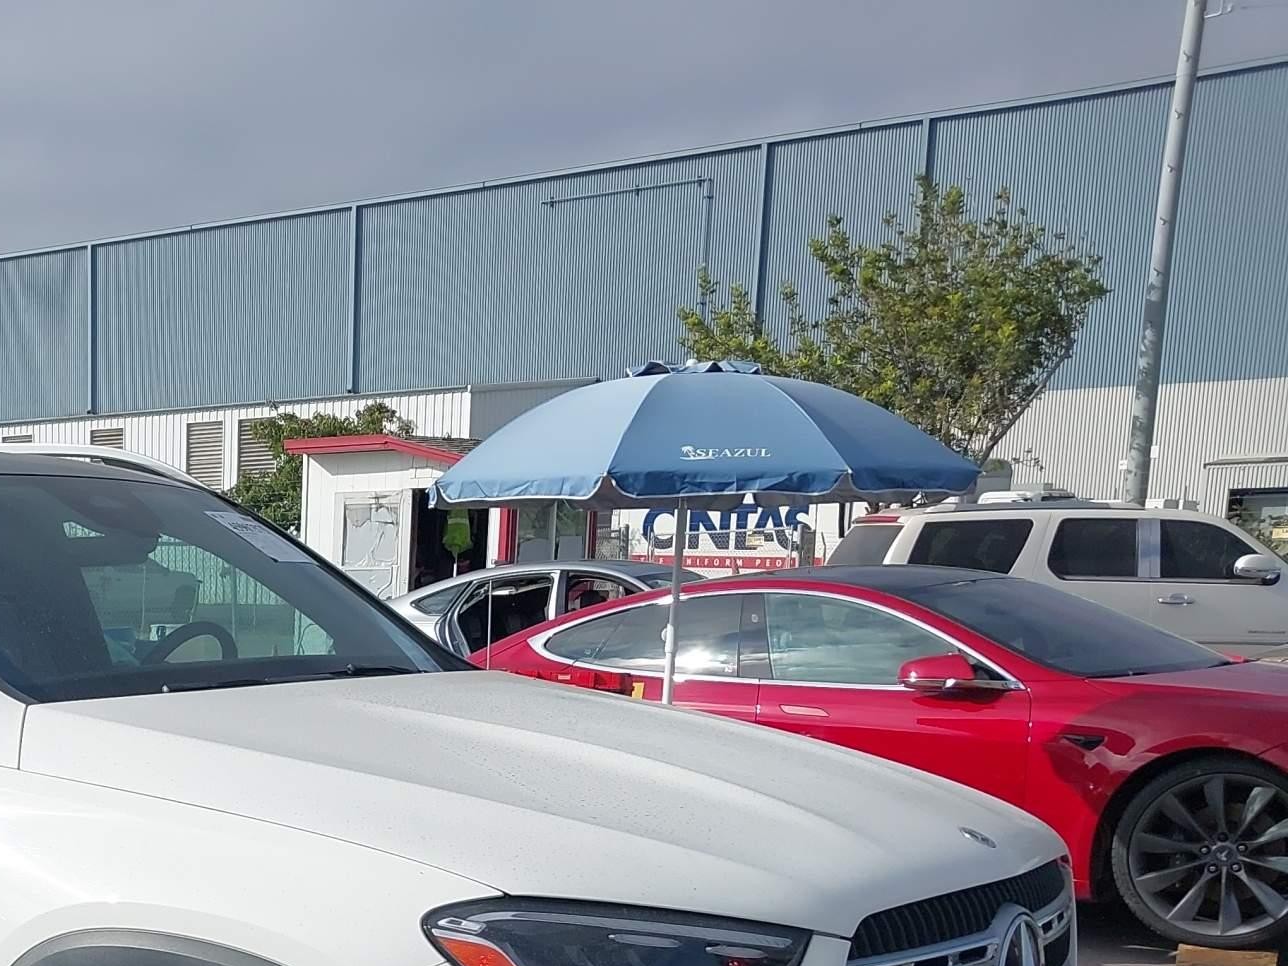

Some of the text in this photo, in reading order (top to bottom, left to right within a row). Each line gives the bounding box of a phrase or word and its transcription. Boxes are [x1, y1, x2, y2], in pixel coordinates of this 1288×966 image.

[695, 448, 771, 457] SEAZUL
[642, 503, 813, 550] CNTAS
[685, 557, 744, 568] NIFORM
